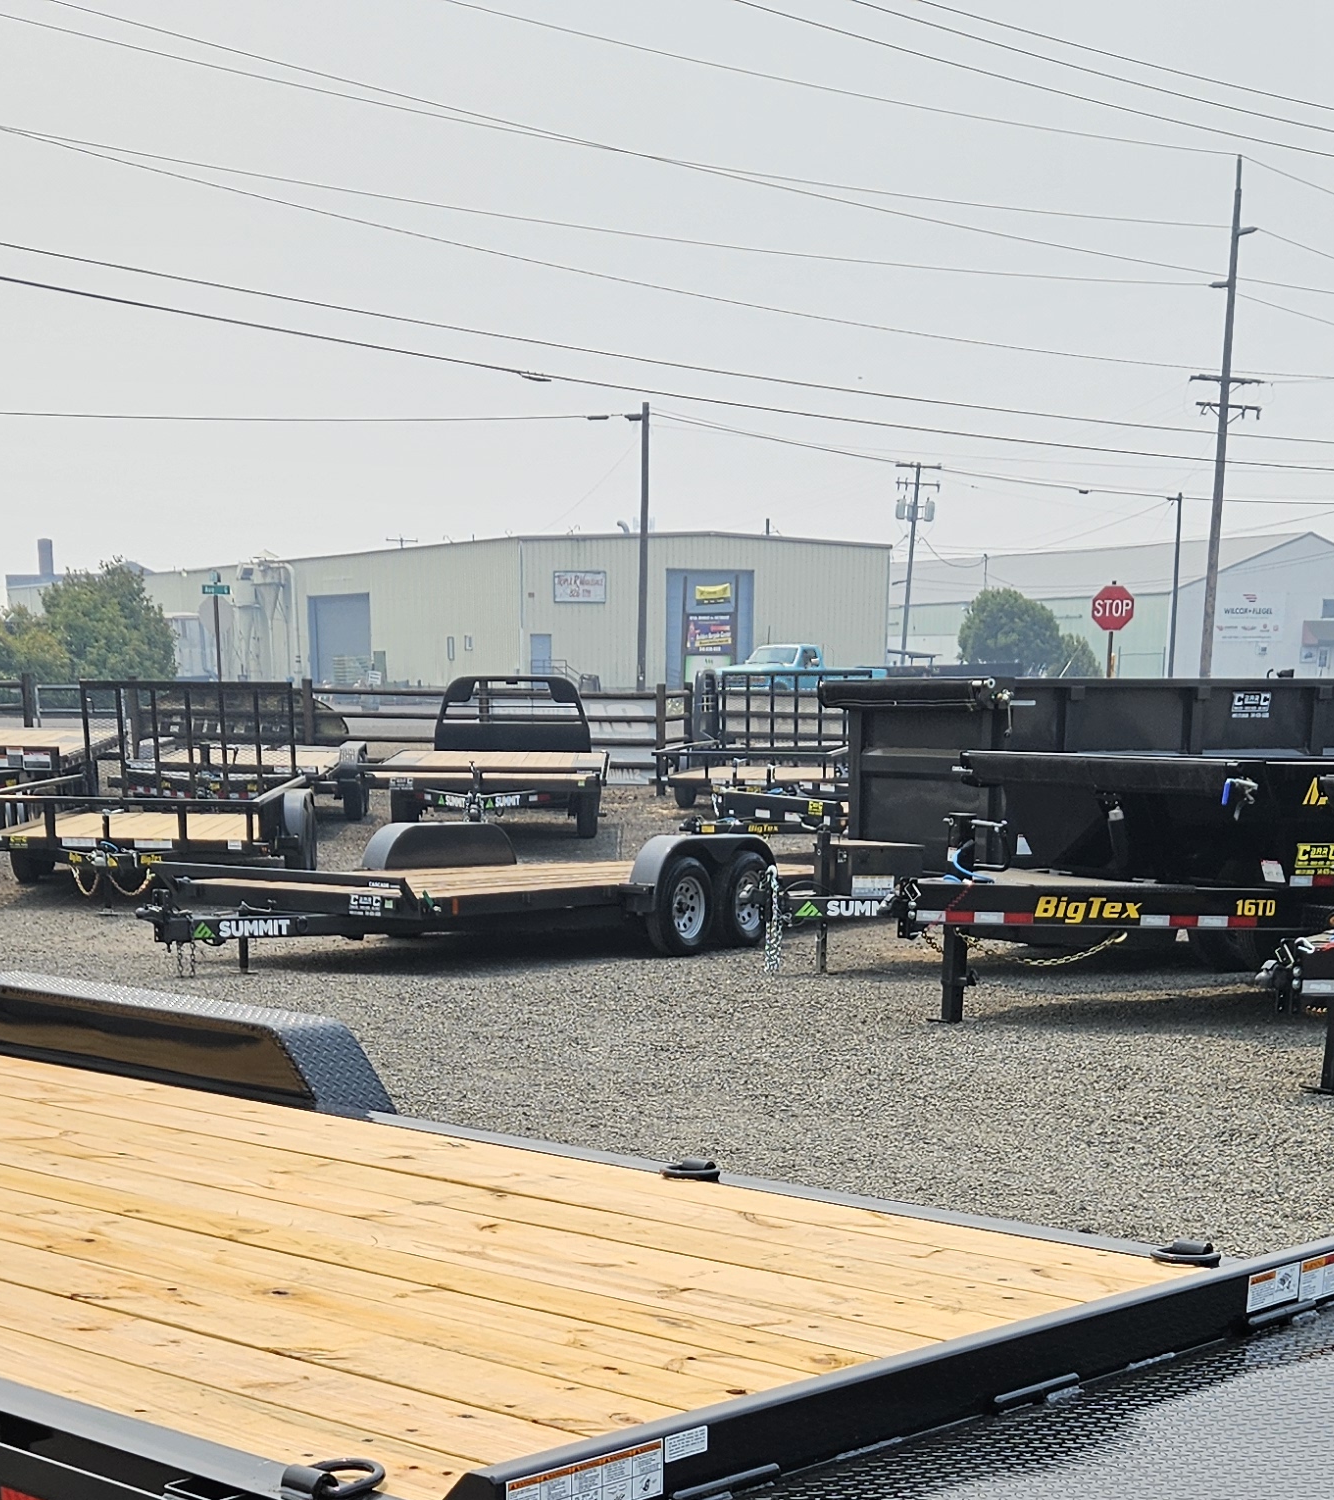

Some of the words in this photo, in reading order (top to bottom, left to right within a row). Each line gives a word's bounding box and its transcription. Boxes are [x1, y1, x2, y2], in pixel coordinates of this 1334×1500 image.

[1093, 599, 1132, 617] STOP
[1034, 896, 1143, 924] BigTex
[1235, 899, 1276, 917] 16TD
[219, 918, 291, 938] SUMMIT
